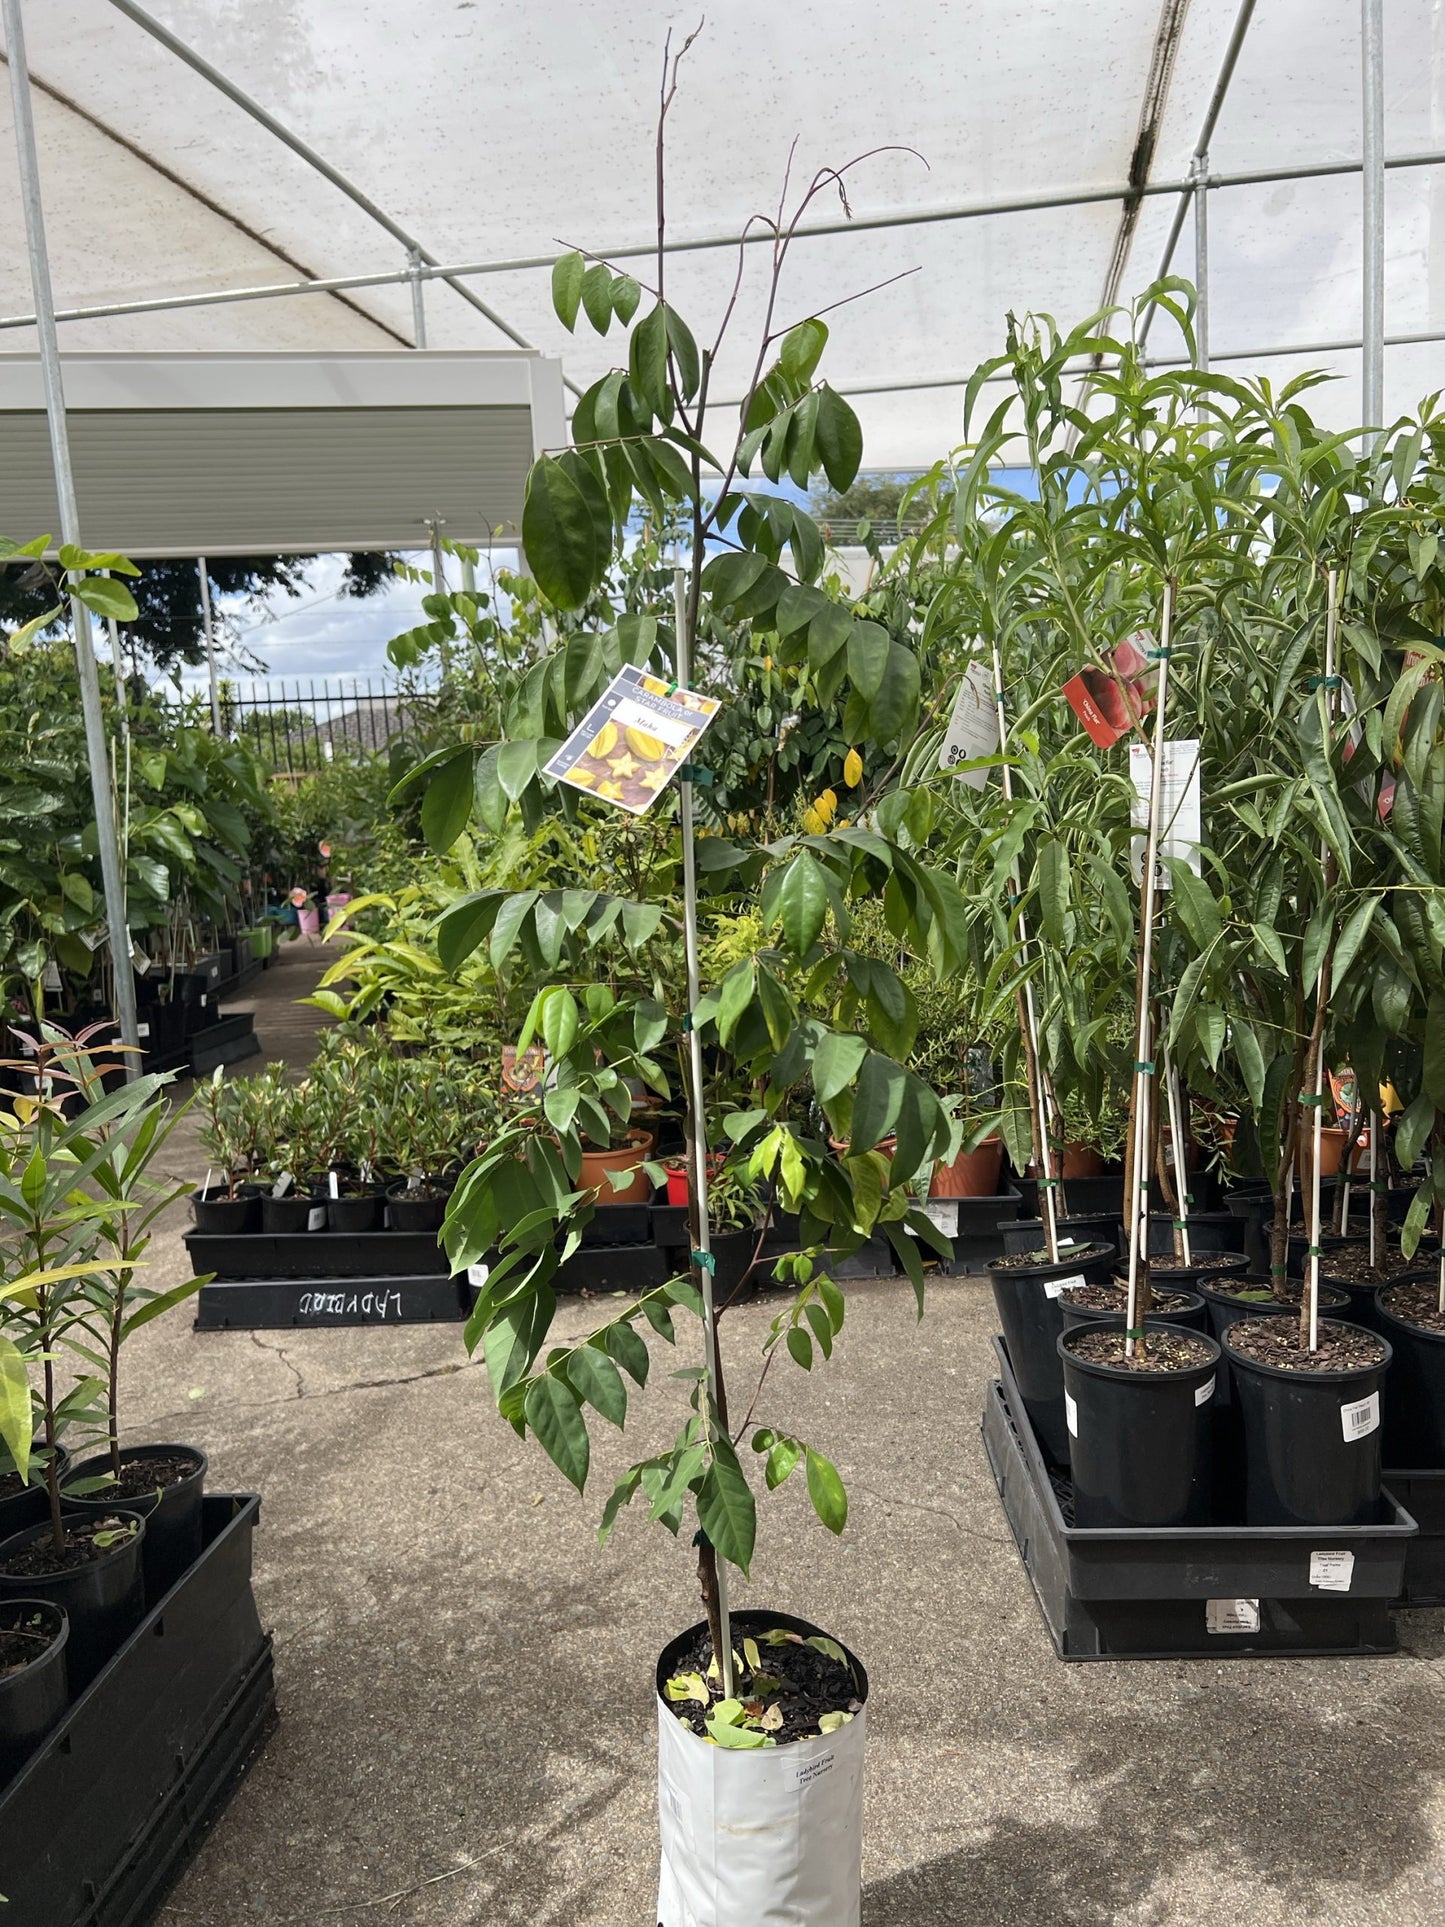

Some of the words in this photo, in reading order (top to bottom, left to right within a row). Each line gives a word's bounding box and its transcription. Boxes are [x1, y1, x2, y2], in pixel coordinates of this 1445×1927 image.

[631, 686, 683, 713] CARAMBOLA
[635, 695, 657, 710] STAR
[656, 703, 684, 719] FRUIT
[300, 1289, 402, 1319] LADYBIRD
[796, 1761, 821, 1778] Ladybird
[820, 1754, 835, 1766] Fruit
[799, 1775, 812, 1784] Tree
[811, 1764, 833, 1778] Nursery
